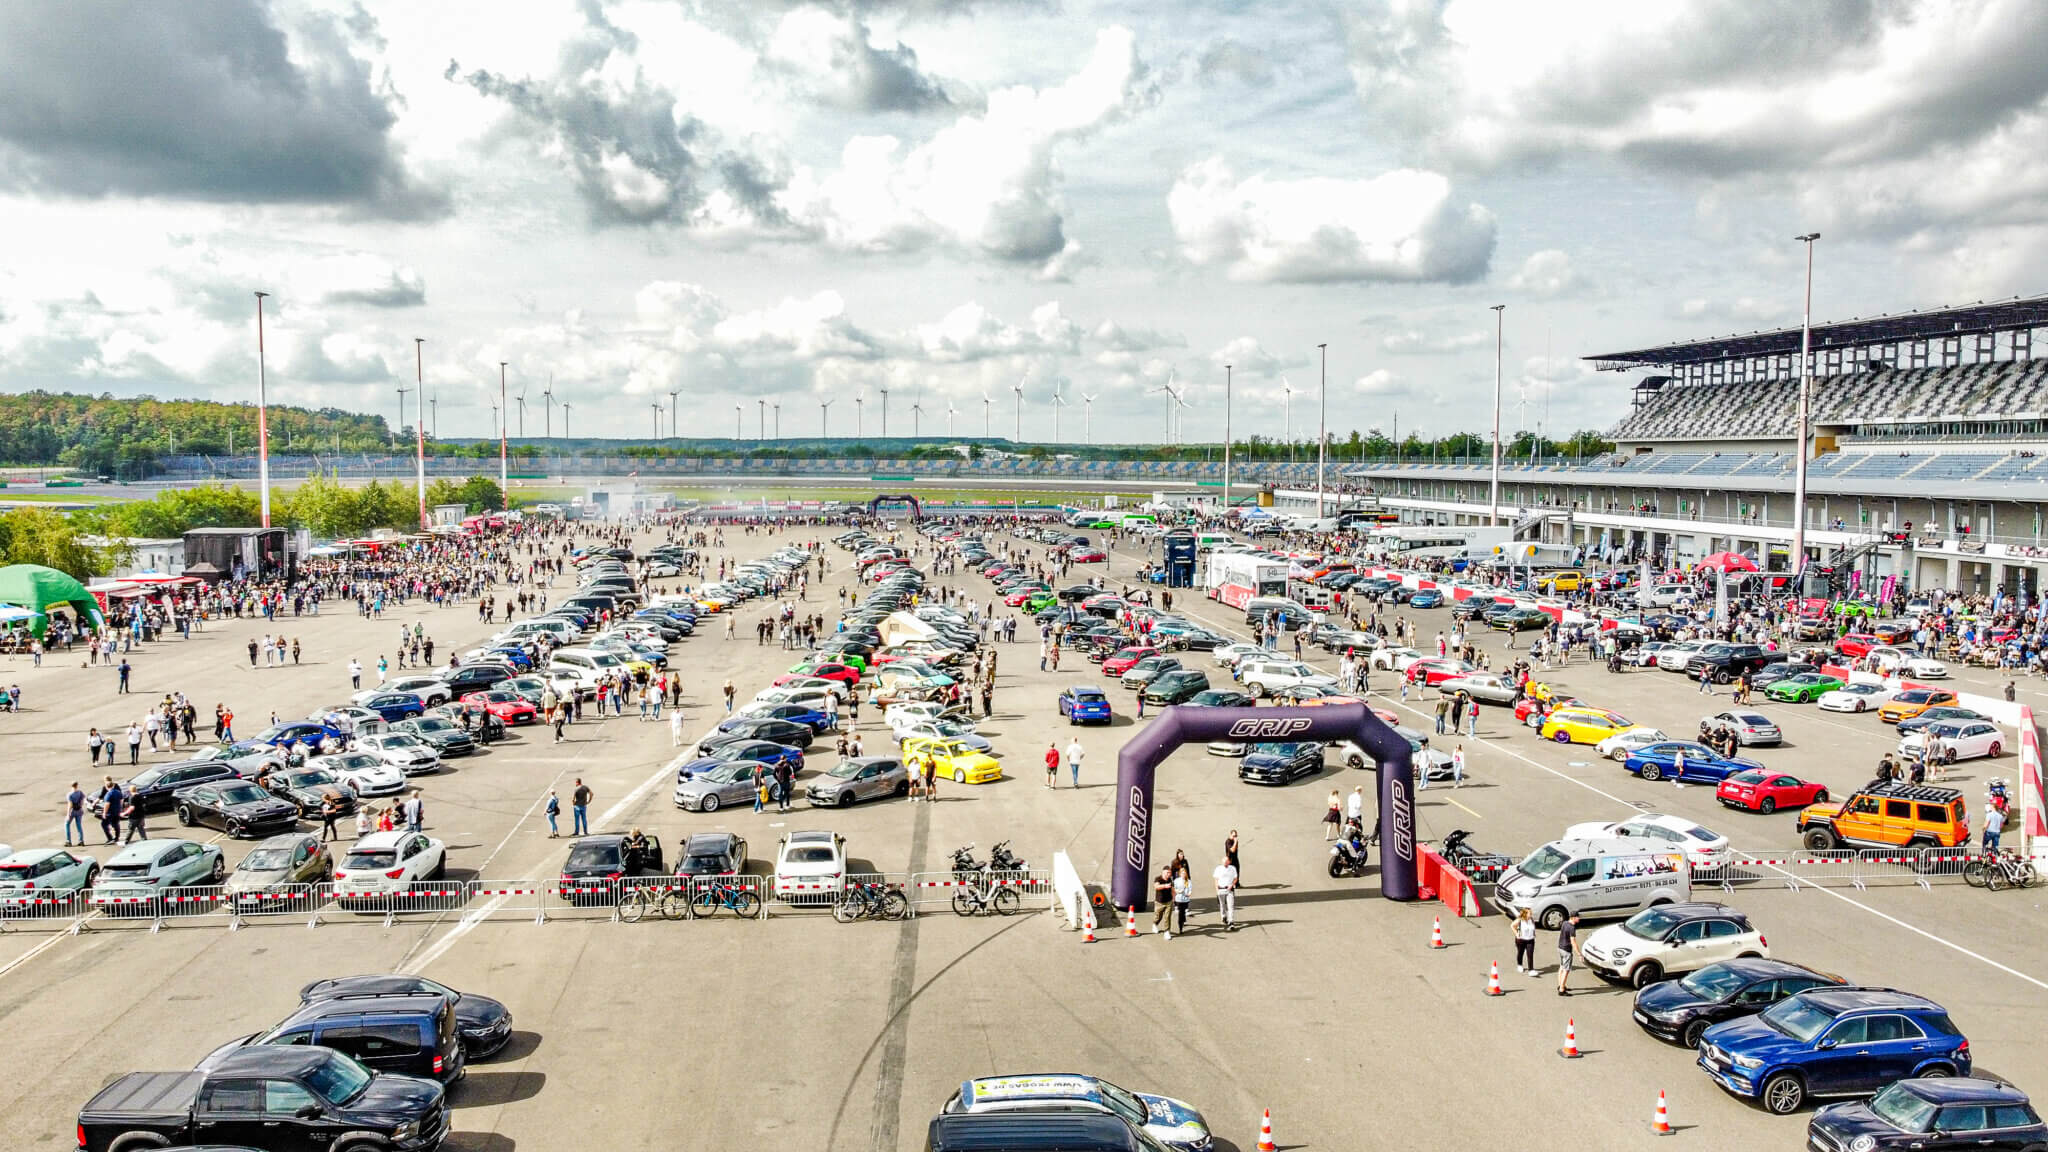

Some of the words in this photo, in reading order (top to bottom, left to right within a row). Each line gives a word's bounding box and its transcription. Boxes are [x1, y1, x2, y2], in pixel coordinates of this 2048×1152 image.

[1229, 718, 1312, 737] GRIP
[1127, 786, 1147, 871] GRIP
[1392, 779, 1412, 861] GRIP
